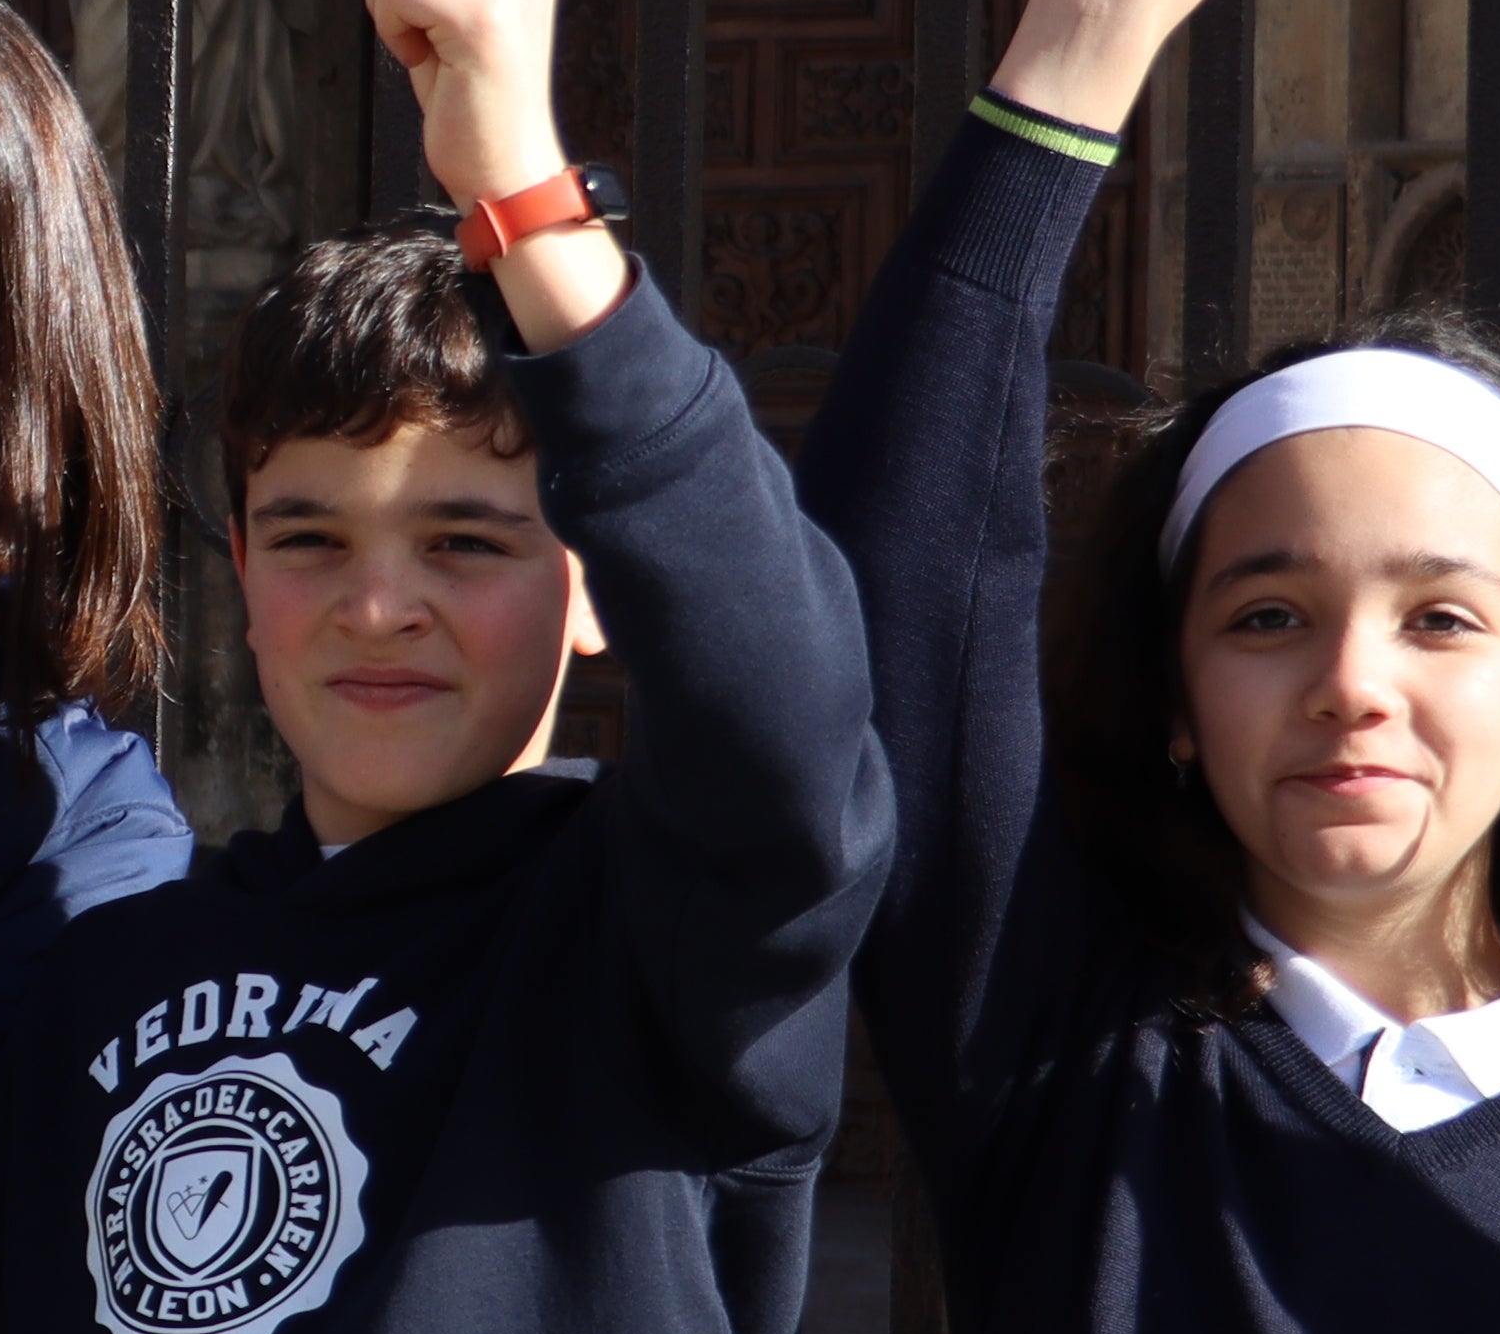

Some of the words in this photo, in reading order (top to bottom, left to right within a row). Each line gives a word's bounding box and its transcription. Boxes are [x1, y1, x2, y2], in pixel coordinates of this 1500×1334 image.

[123, 1101, 184, 1172] SRA
[193, 1084, 257, 1123] DEL
[263, 1110, 323, 1280] CARMEN
[135, 1277, 250, 1322] LEON
